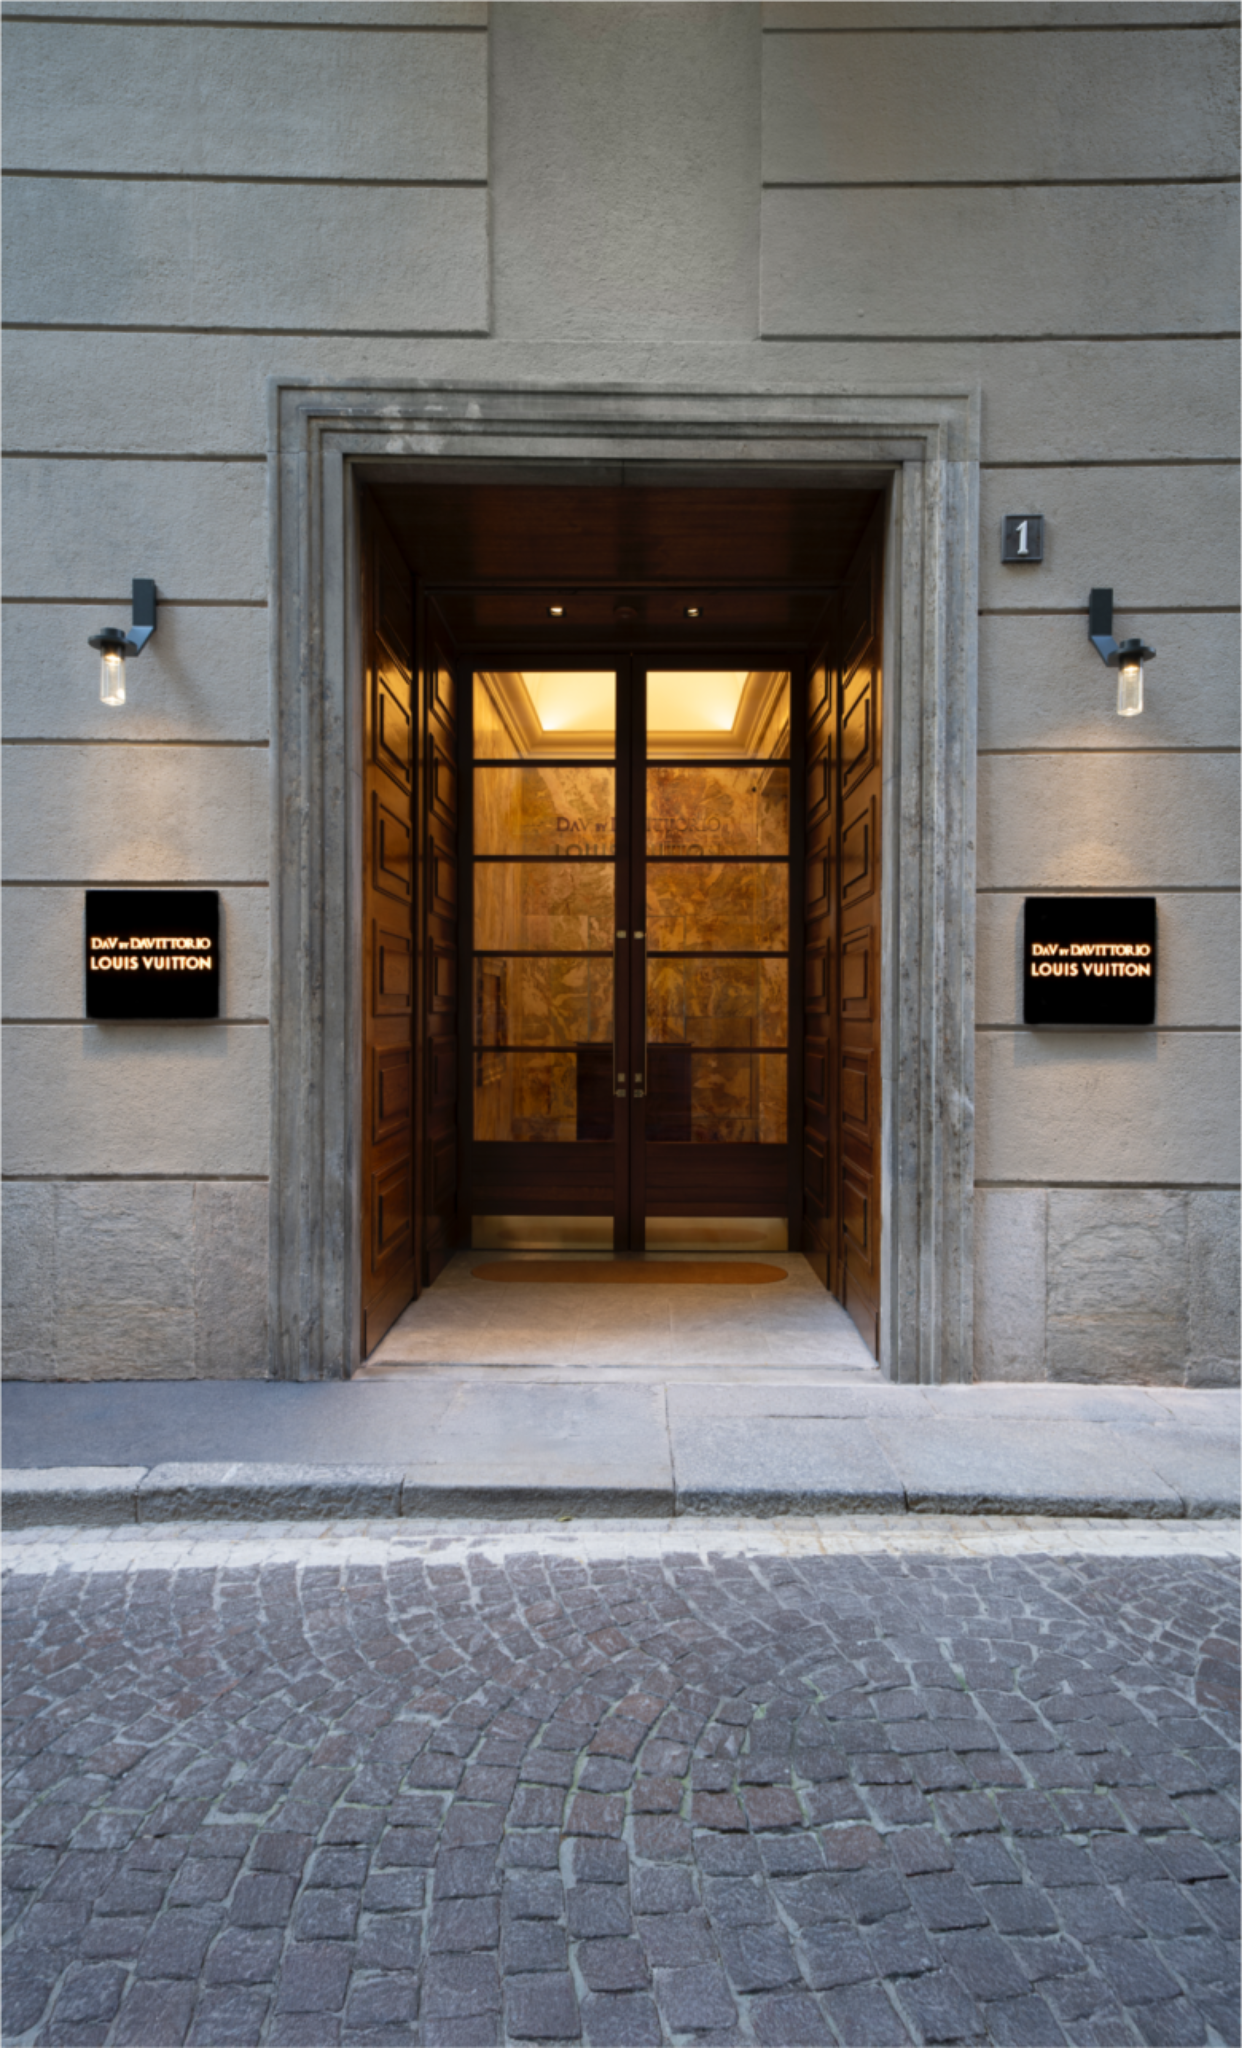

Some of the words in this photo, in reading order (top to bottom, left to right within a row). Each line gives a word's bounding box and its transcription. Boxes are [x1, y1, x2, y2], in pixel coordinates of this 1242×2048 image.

[1015, 520, 1029, 555] 1
[90, 956, 139, 970] LOUIS
[141, 956, 213, 970] VUITTON
[1031, 962, 1079, 977] LOUIS
[1081, 962, 1151, 977] VUITTON
